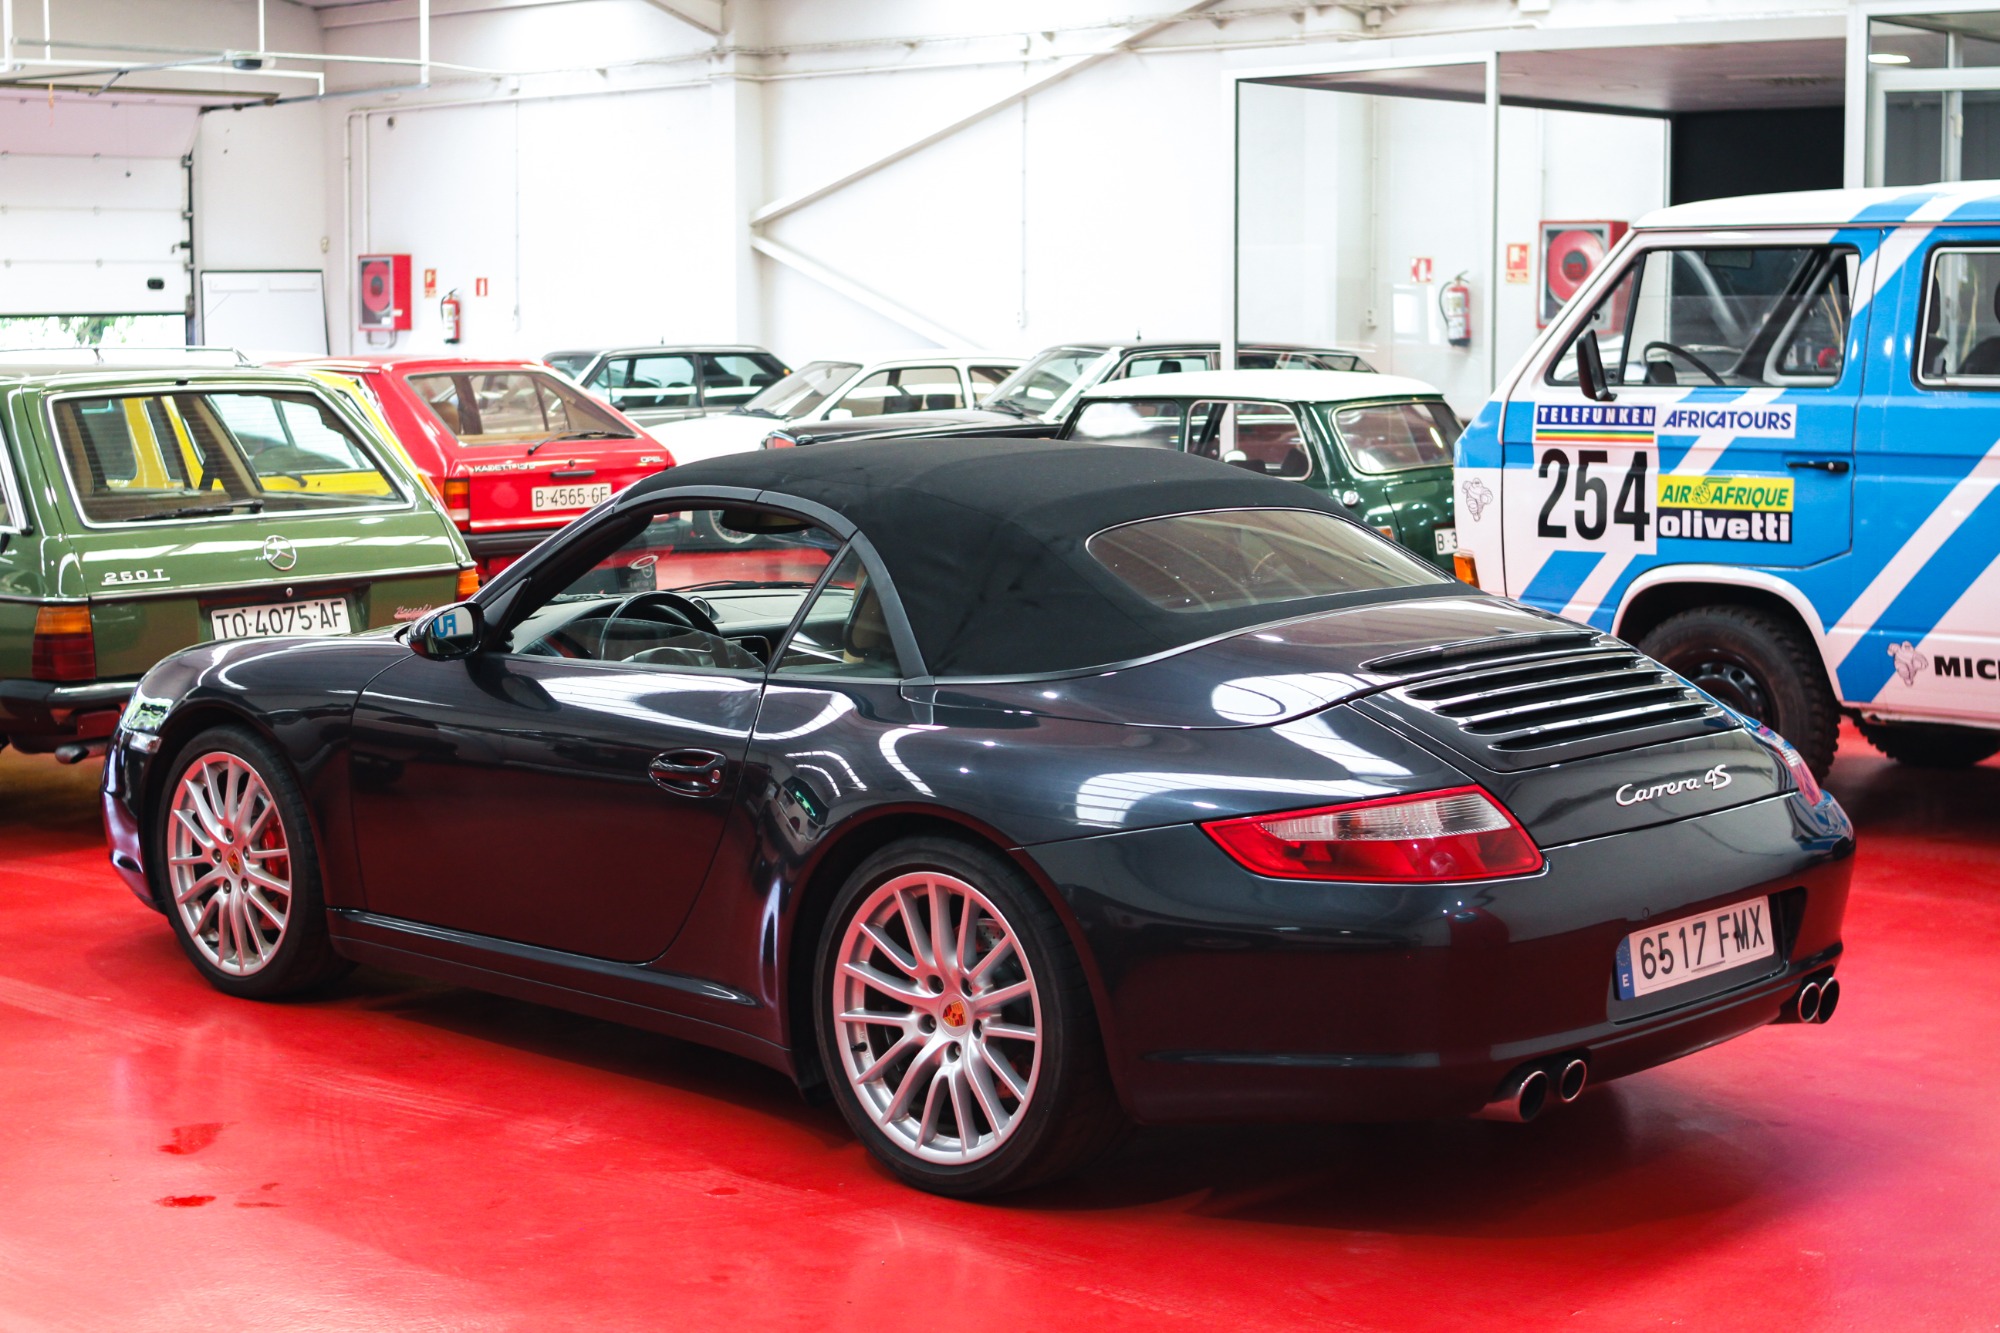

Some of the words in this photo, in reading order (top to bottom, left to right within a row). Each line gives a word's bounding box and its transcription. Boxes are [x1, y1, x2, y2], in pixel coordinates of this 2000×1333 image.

[1539, 407, 1655, 425] TELEFUNKEN
[1662, 409, 1792, 430] AFRICATOURS
[1537, 448, 1650, 542] 254
[1661, 484, 1692, 504] AIR
[1709, 486, 1789, 508] AFRIQUE
[1659, 510, 1790, 543] olivetti
[104, 569, 149, 583] 250
[153, 568, 164, 579] T
[1934, 655, 2000, 680] MIC
[1615, 776, 1701, 806] Carrera
[1704, 764, 1732, 790] 4S
[1639, 920, 1708, 980] 6517
[1717, 904, 1765, 958] FMX
[1621, 973, 1630, 988] E
